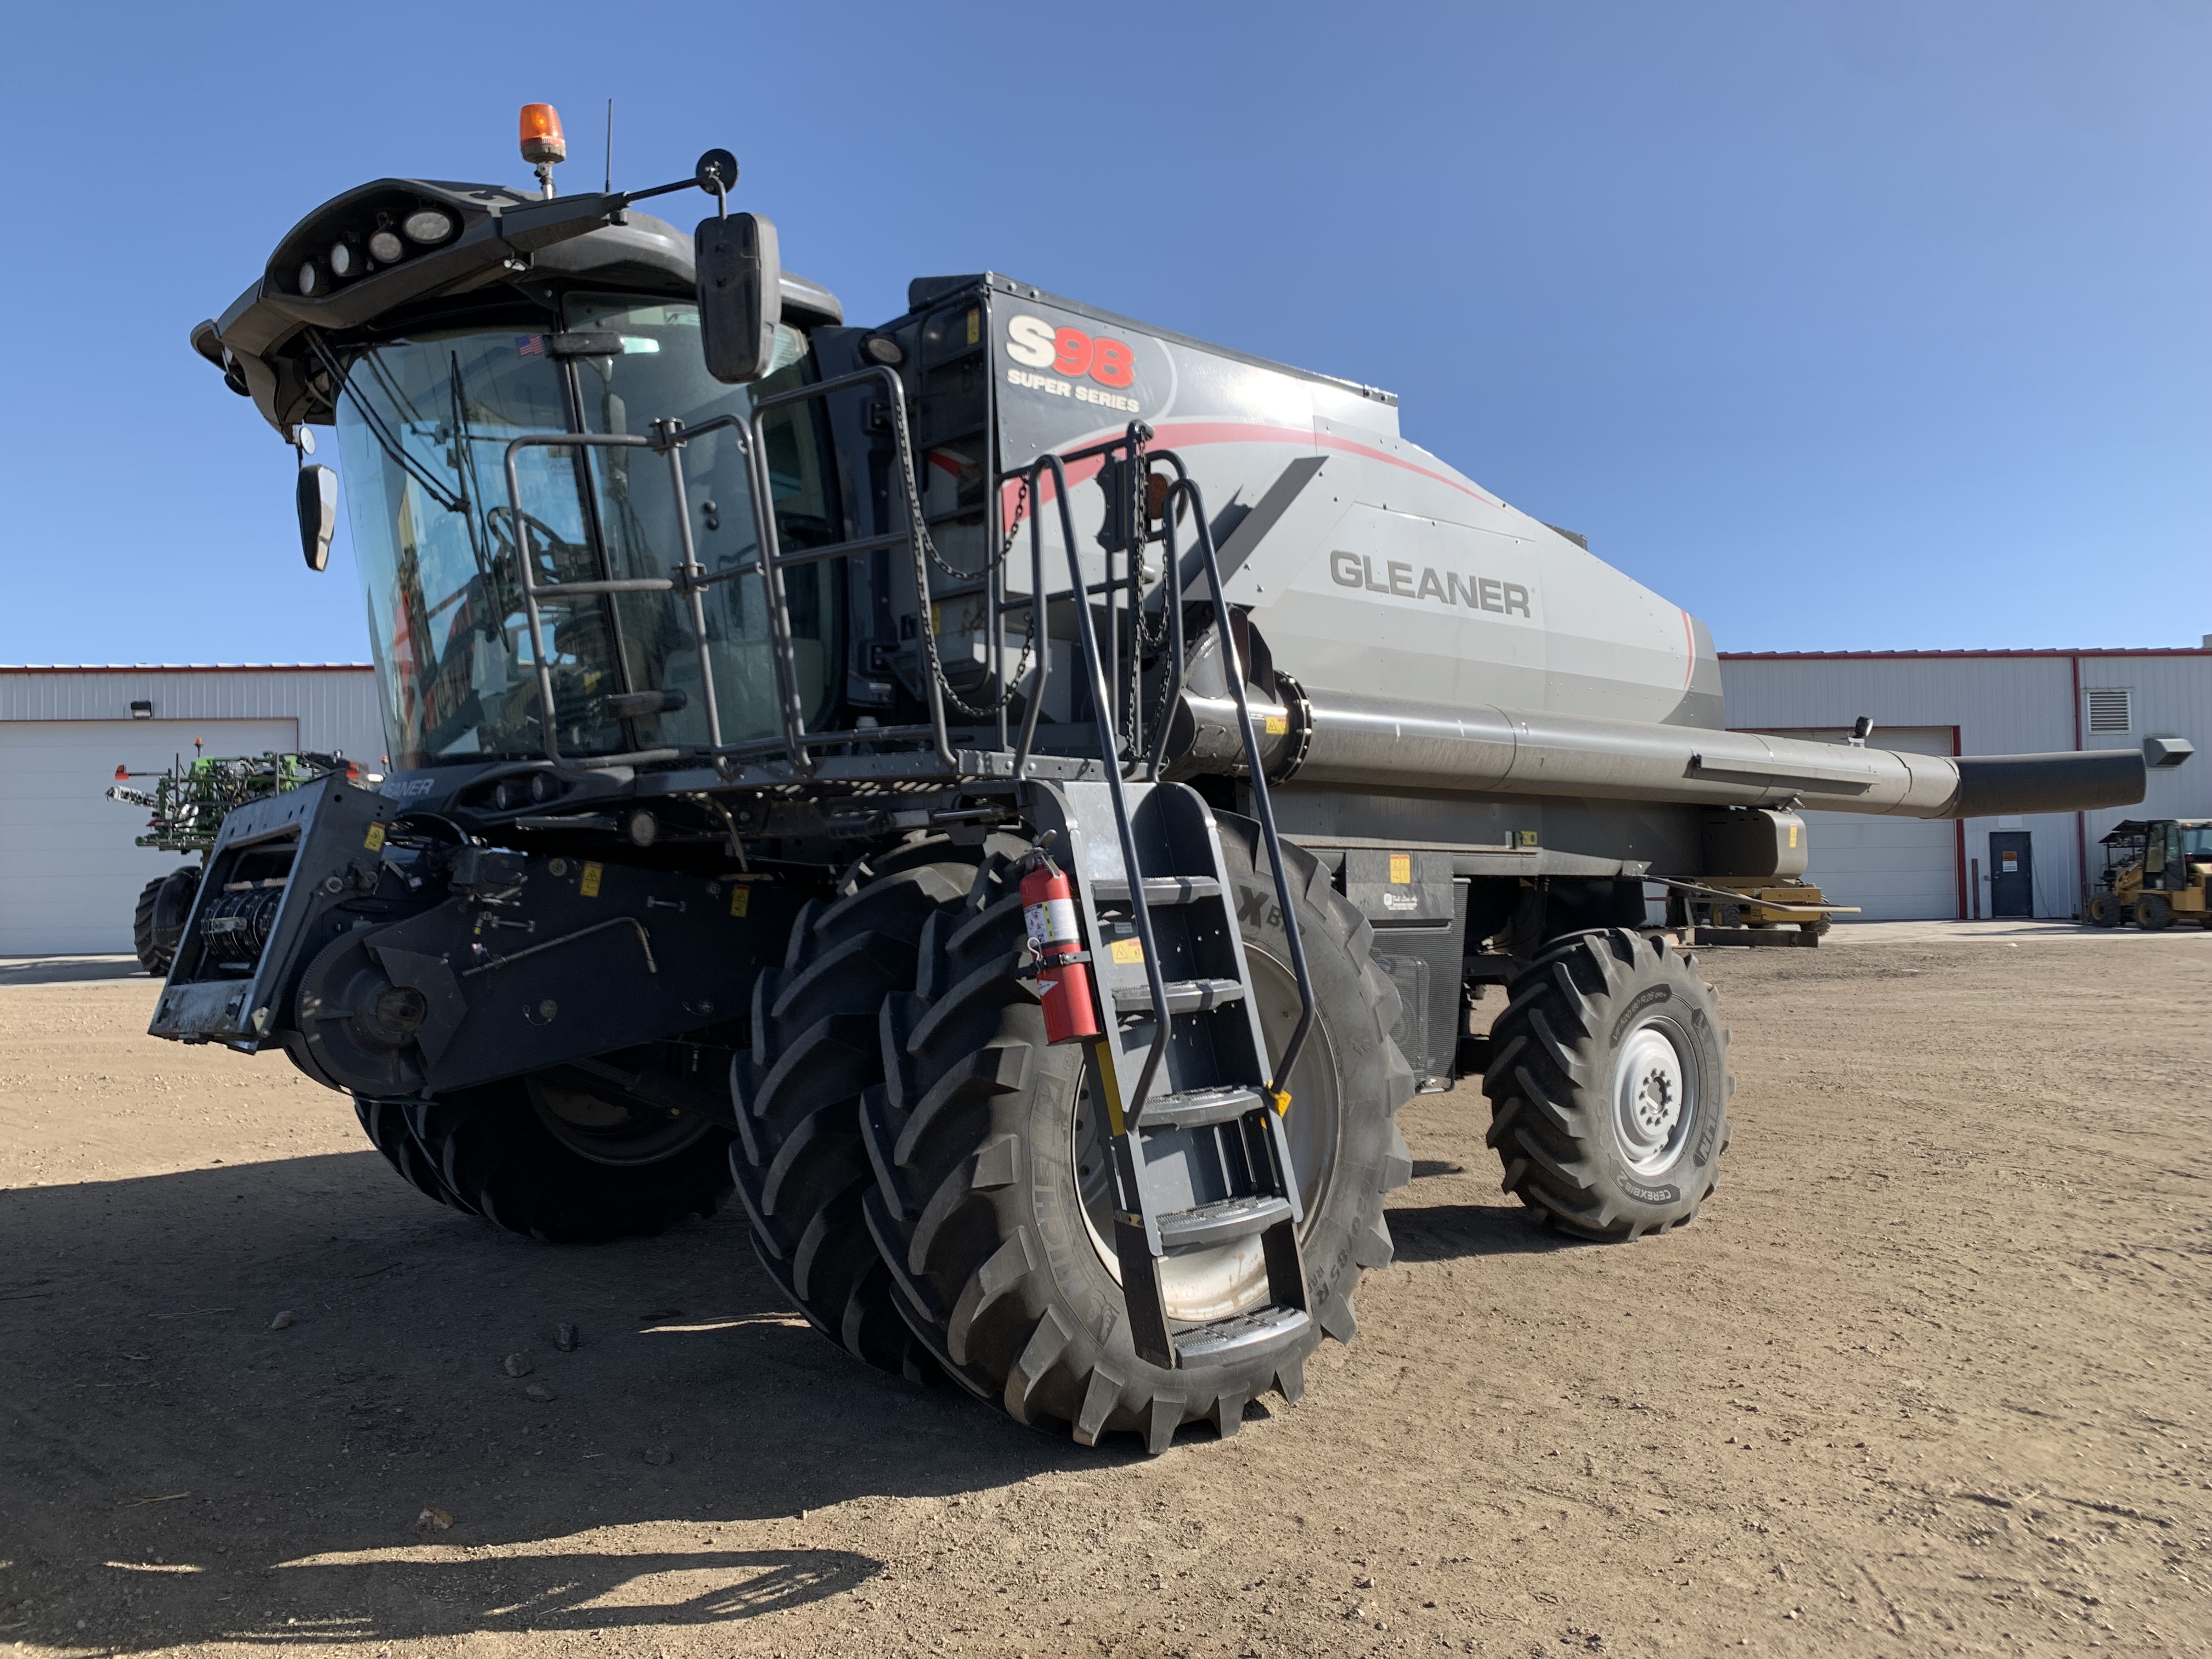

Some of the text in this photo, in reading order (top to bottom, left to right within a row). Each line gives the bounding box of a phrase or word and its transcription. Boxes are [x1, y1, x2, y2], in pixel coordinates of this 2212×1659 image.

[1005, 314, 1135, 390] S98
[1007, 368, 1140, 413] SUPER SERIES
[1330, 549, 1531, 618] GLEANER
[1616, 1171, 1672, 1201] CEREXBIB 2
